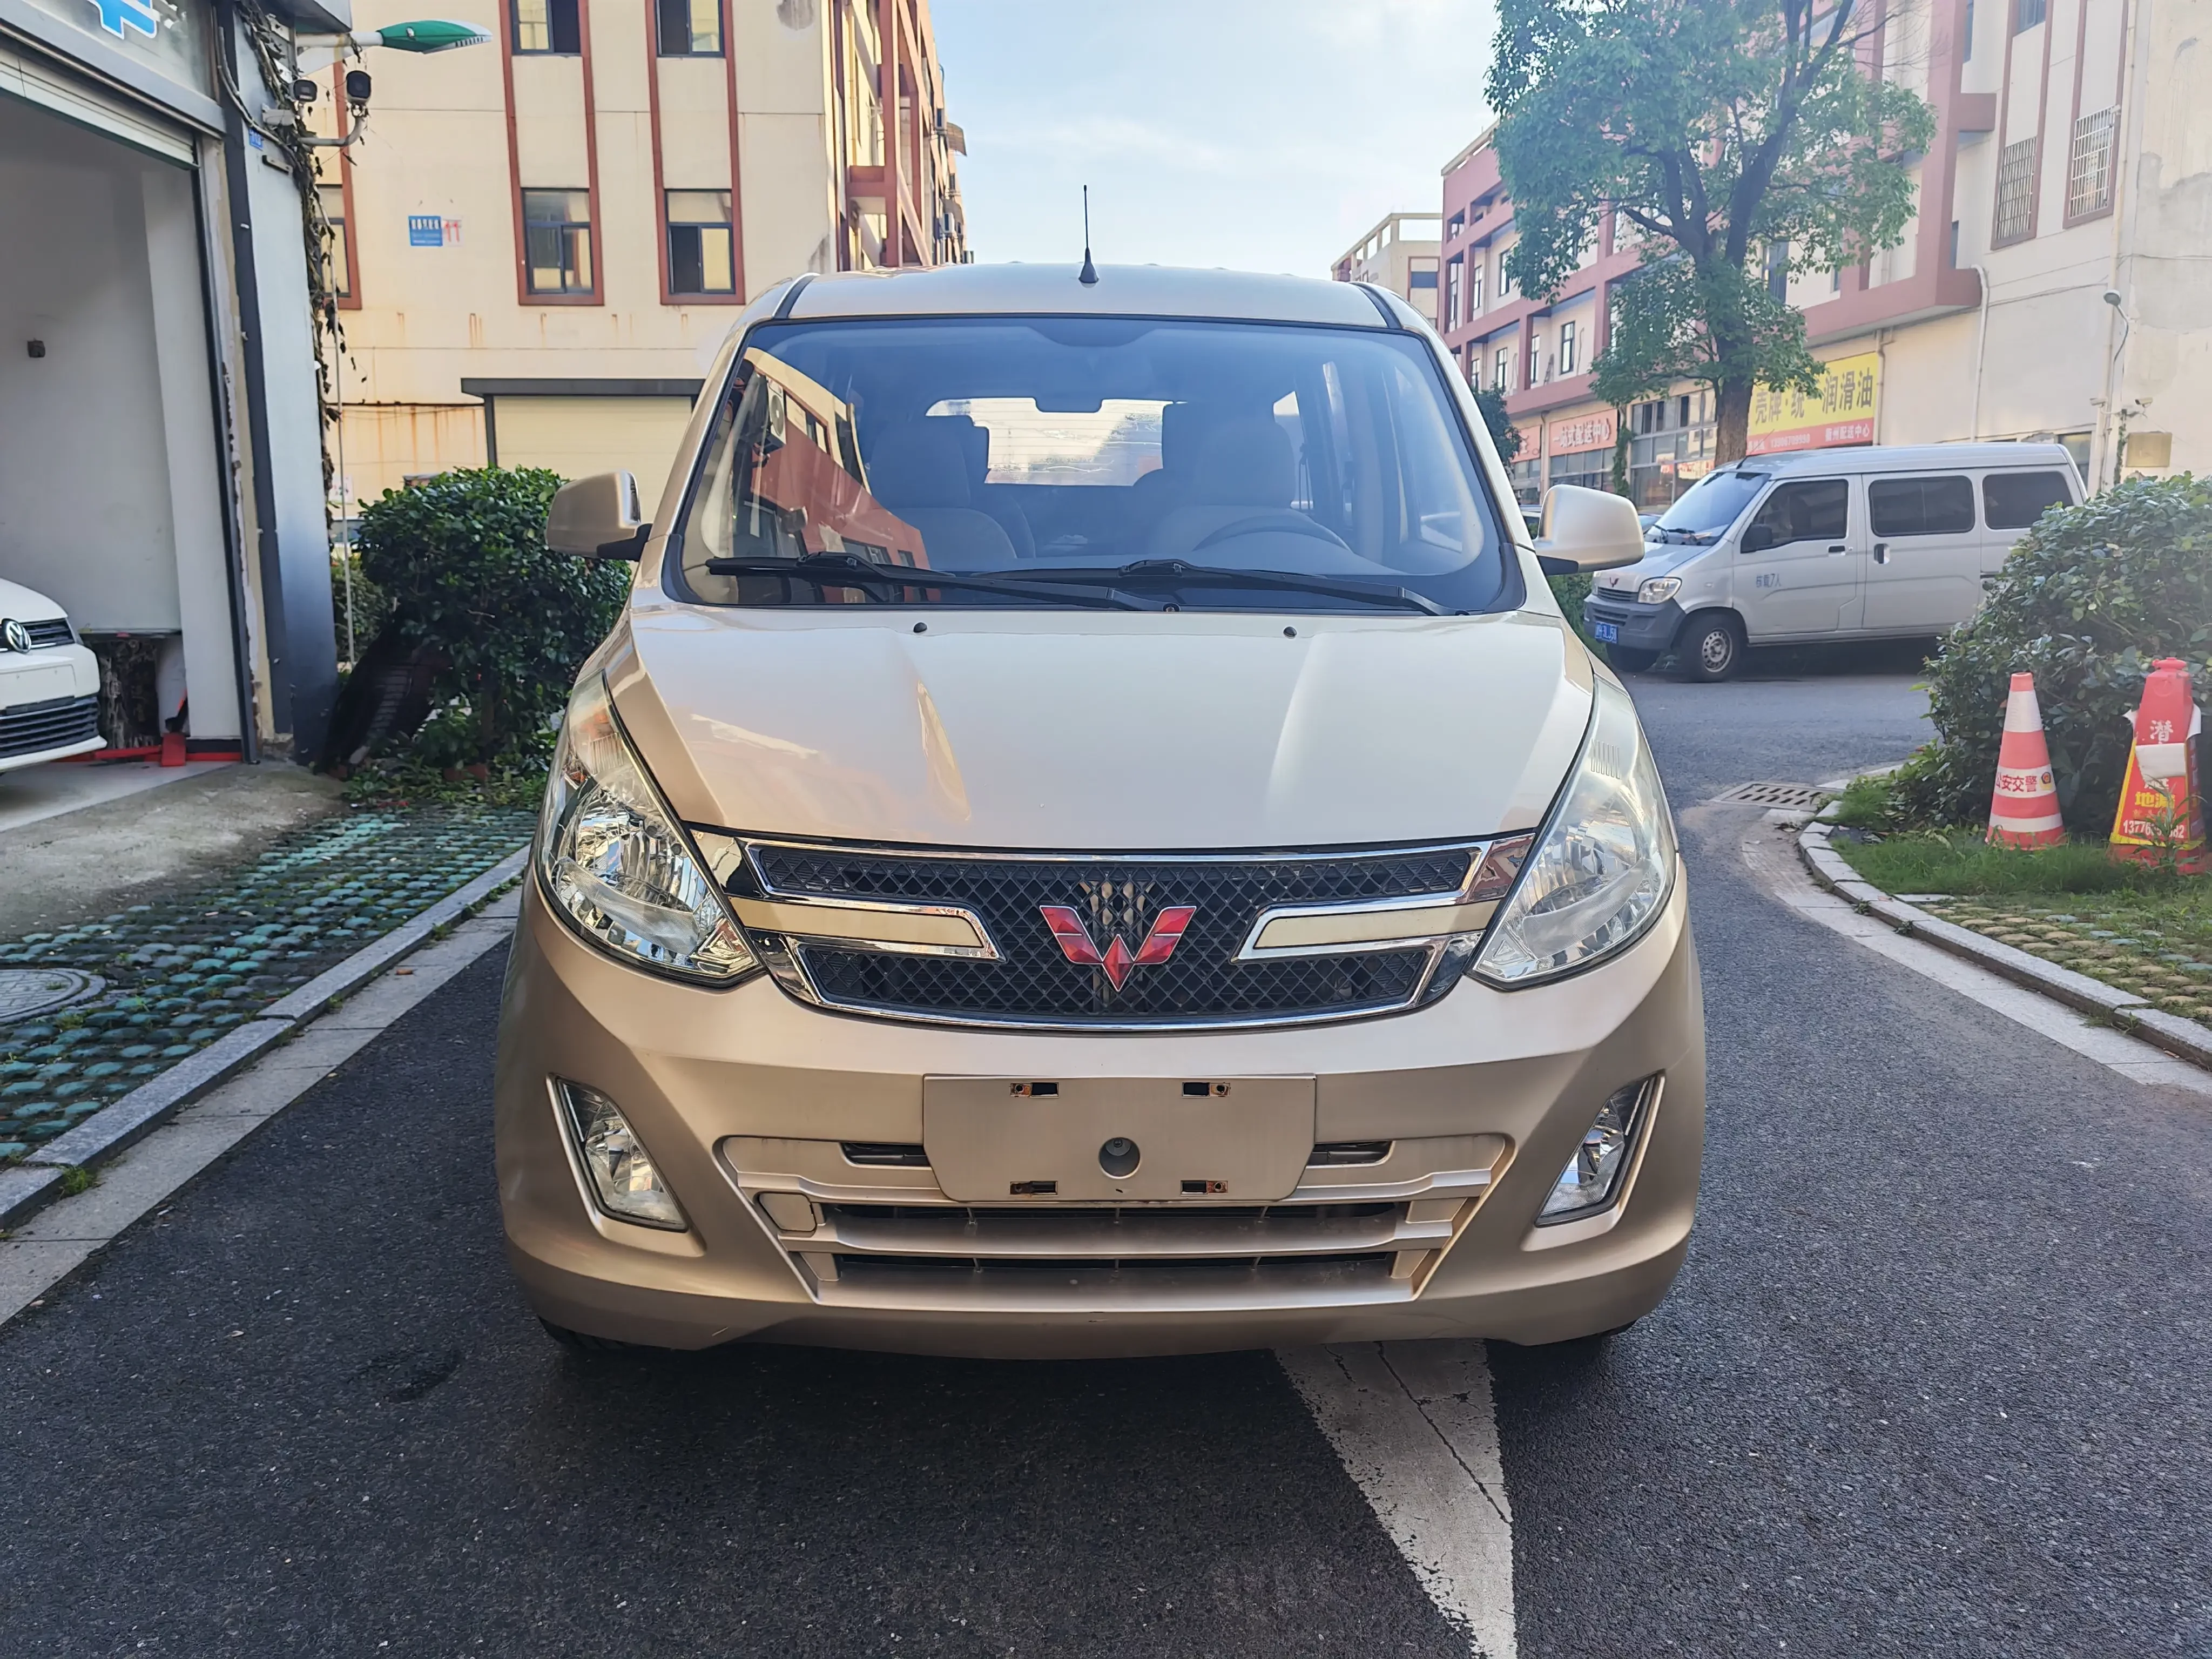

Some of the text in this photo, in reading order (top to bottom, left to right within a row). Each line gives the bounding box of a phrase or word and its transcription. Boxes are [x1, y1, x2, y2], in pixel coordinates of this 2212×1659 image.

[1756, 367, 1873, 425] 壳牌·统润滑油
[1553, 419, 1610, 448] 一站式配送中心
[1996, 772, 2037, 792] 公安交警
